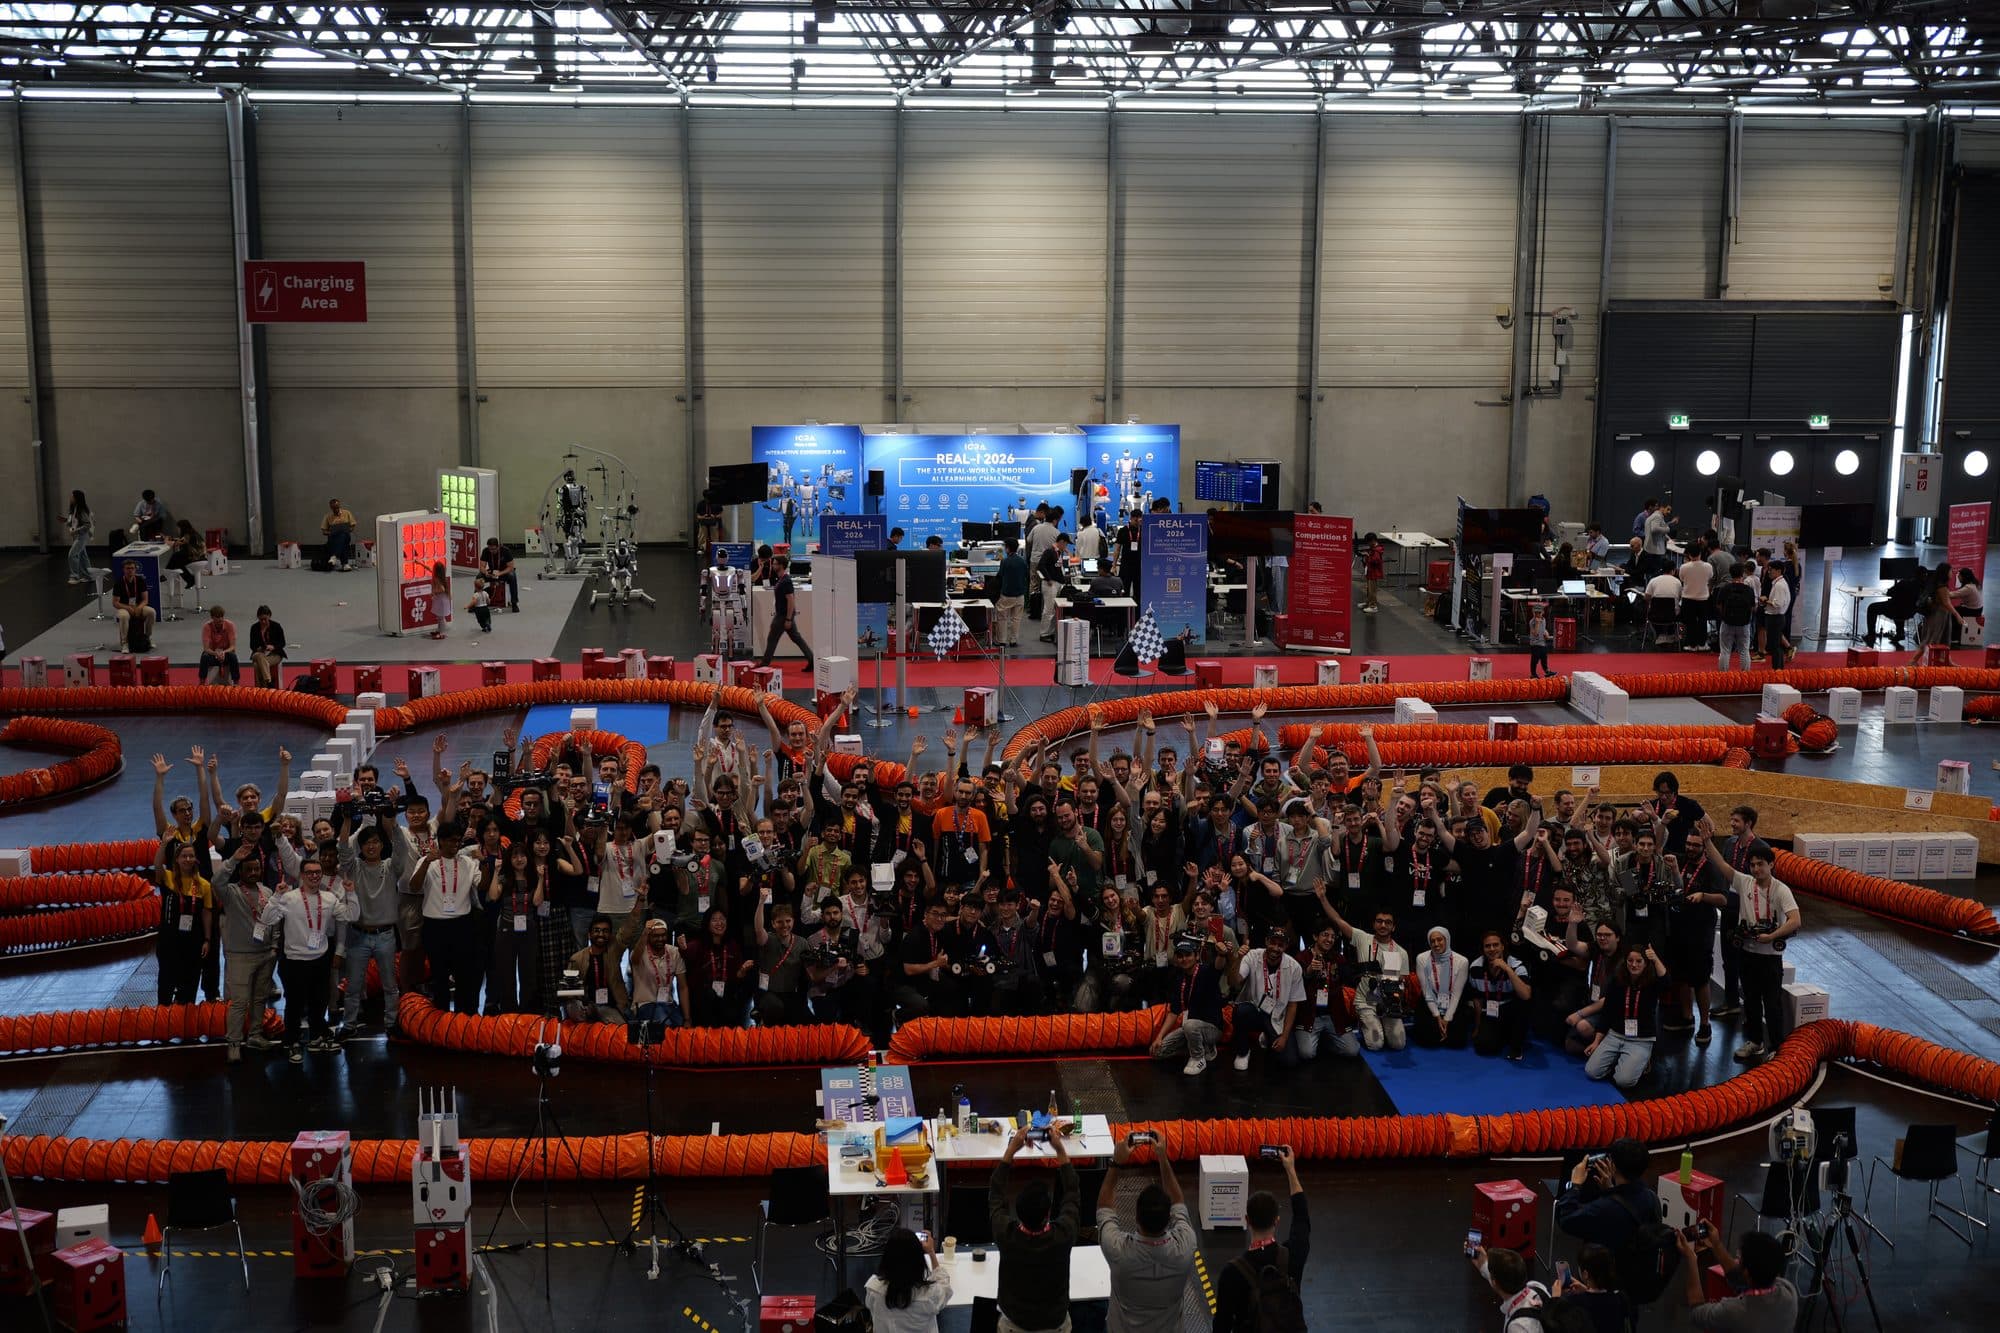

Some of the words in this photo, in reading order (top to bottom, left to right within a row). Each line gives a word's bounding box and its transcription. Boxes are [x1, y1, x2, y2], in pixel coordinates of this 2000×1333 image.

[283, 275, 355, 292] Charging
[300, 296, 338, 309] Area
[936, 453, 980, 465] REAL-I
[984, 453, 1016, 465] 2026
[836, 520, 872, 530] REAL-I
[1158, 519, 1193, 529] REAL-I
[1951, 520, 1981, 530] Competition
[1295, 531, 1341, 542] Competition
[1341, 534, 1348, 542] 5
